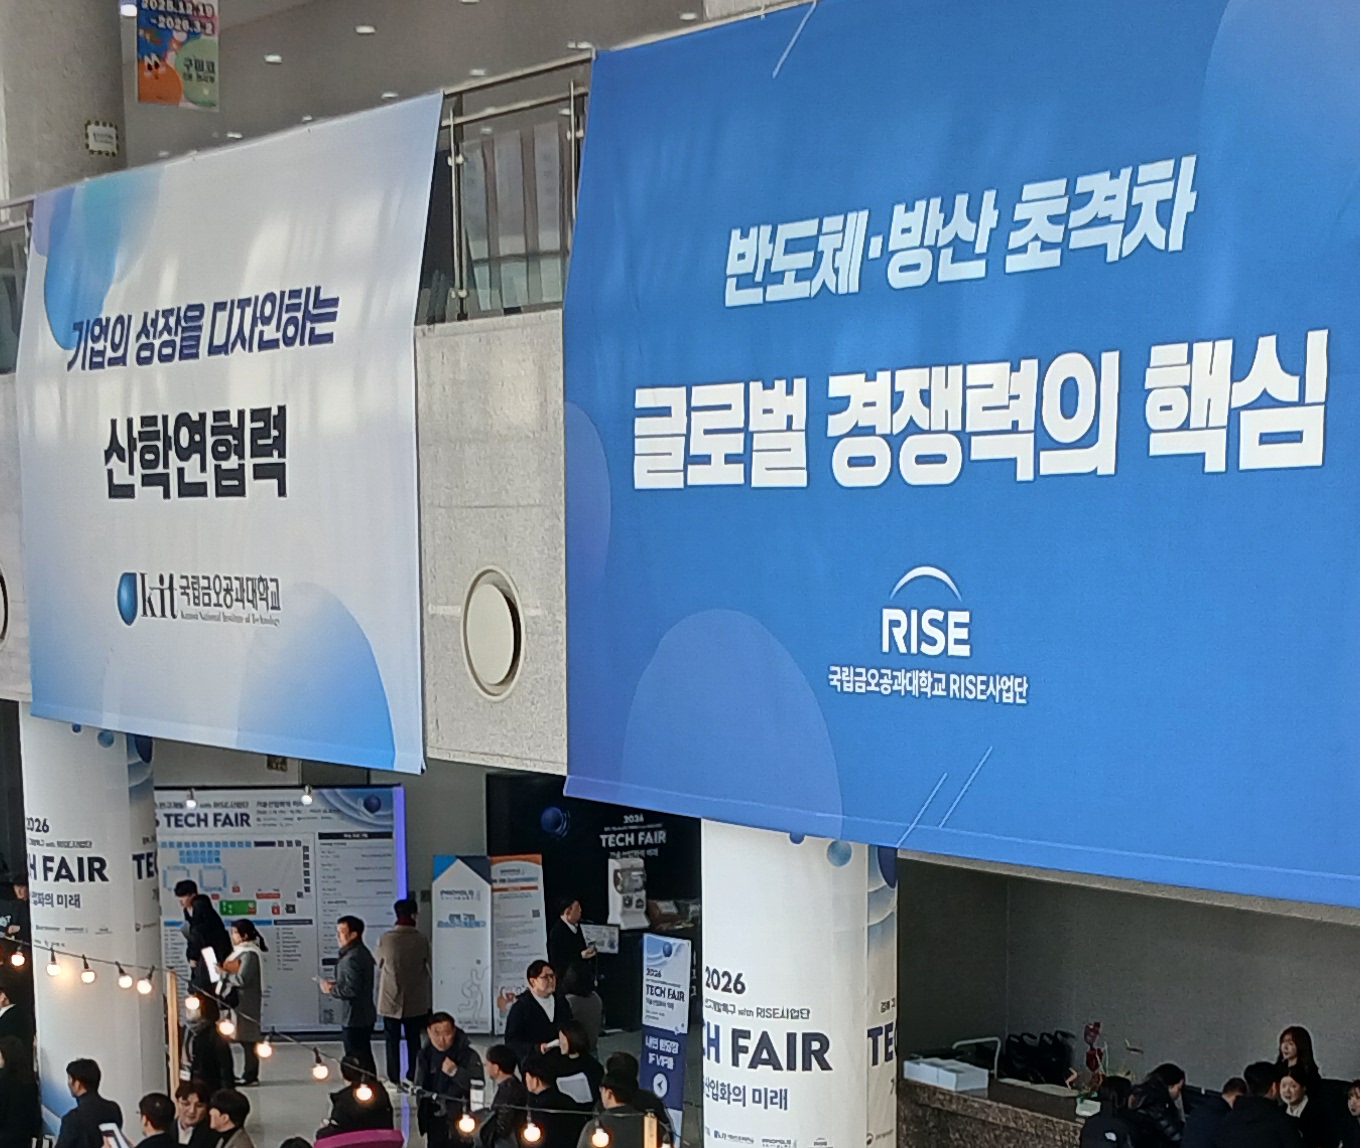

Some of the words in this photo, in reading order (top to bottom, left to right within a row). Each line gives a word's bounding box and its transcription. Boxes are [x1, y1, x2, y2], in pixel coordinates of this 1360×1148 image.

[725, 191, 1000, 308] 반도체·방산
[1006, 155, 1198, 274] 초격차
[67, 314, 133, 371] 기업의
[135, 302, 205, 366] 성장을
[207, 285, 340, 357] 디자인하는
[633, 377, 809, 491] 글로벌
[827, 351, 1120, 489] 경쟁력의
[1144, 328, 1329, 474] 핵심
[104, 404, 288, 500] 산학연협력
[140, 572, 178, 620] kit
[178, 574, 282, 612] 국립금오공과대학교
[881, 607, 971, 657] RISE
[828, 665, 948, 698] 국립금오공과대학교
[949, 673, 1029, 705] RISE사업단
[163, 811, 207, 828] TECH
[212, 811, 252, 828] FAIR
[599, 832, 635, 848] TECH
[638, 829, 667, 846] FAIR
[42, 855, 110, 883] FAIR
[646, 984, 667, 999] TECH
[704, 965, 746, 995] 2026
[731, 1028, 834, 1072] FAIR
[751, 1086, 788, 1111] 미래
